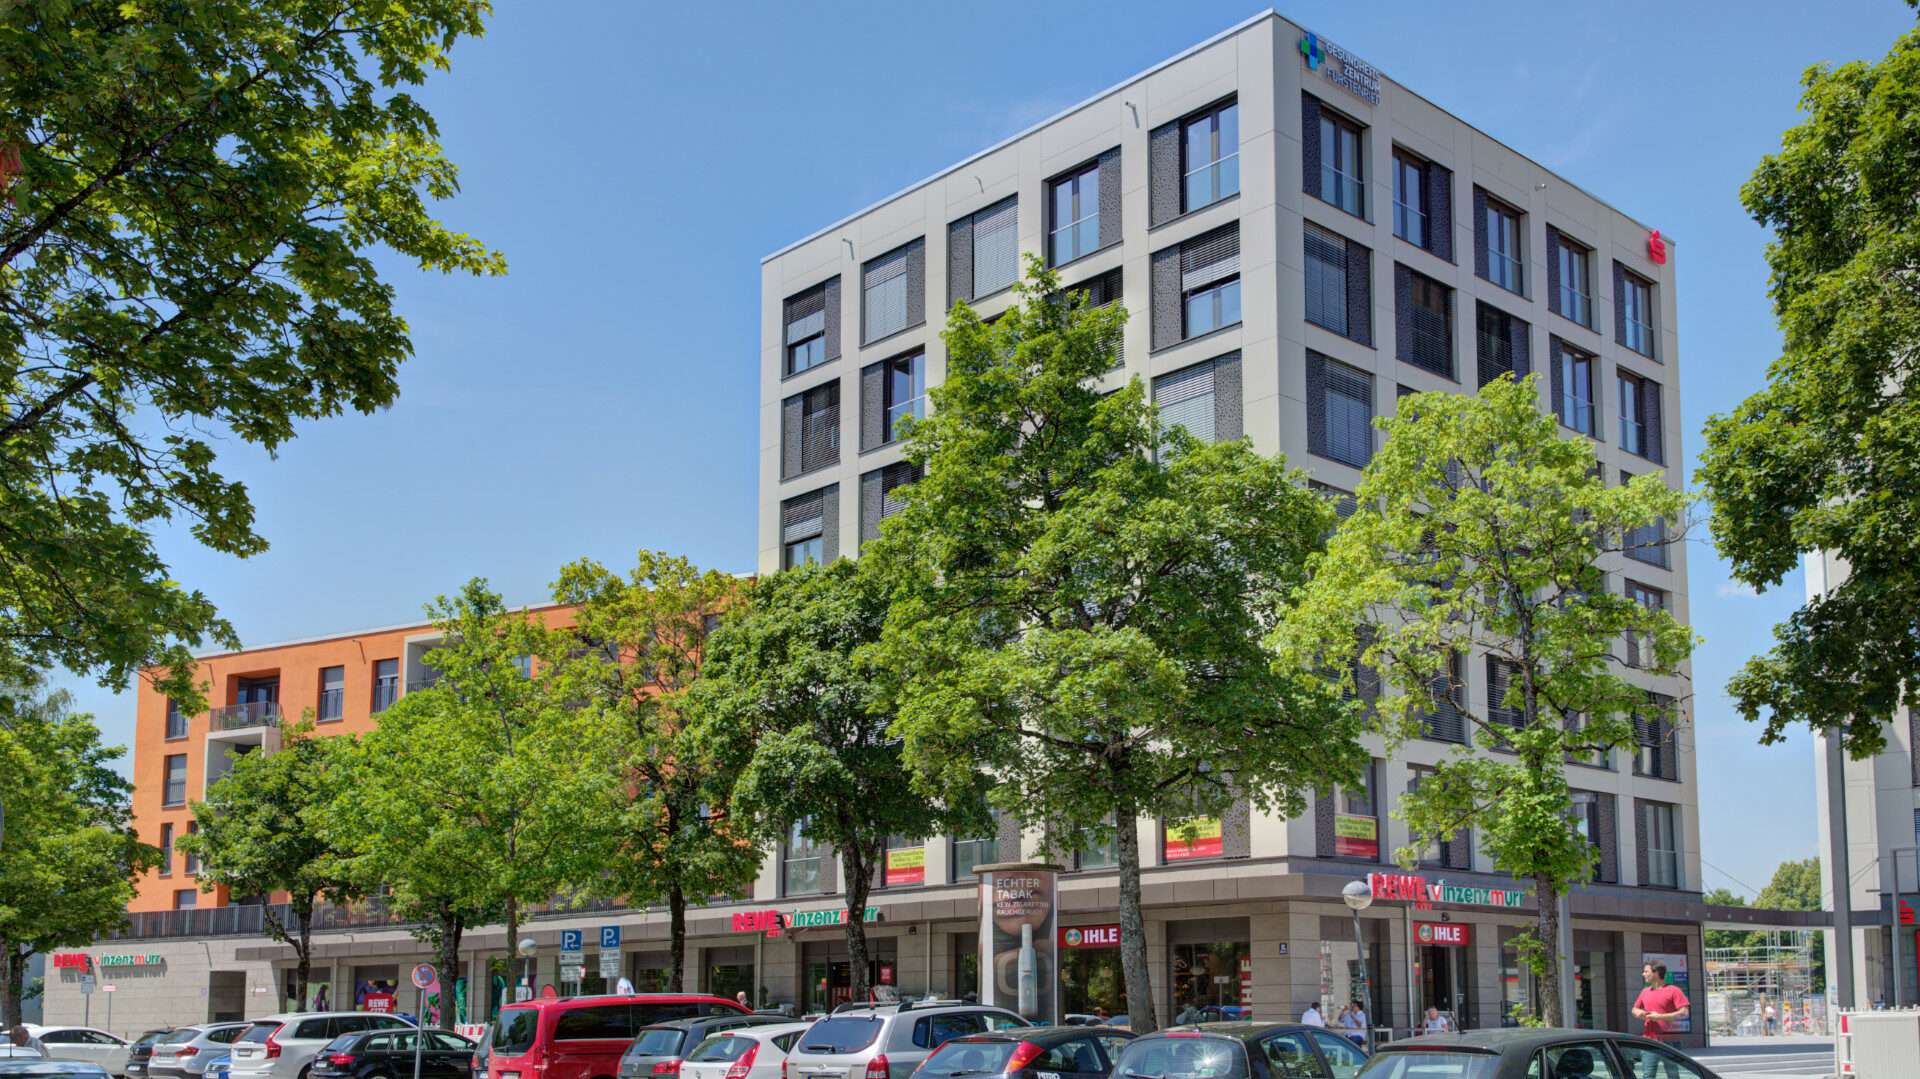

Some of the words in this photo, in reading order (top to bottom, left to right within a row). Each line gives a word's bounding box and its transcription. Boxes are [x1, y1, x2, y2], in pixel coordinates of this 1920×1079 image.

[1343, 65, 1381, 94] ZENTRUM
[997, 878, 1040, 888] ECHTER
[1368, 873, 1427, 900] REWE
[997, 889, 1033, 900] TABAK
[732, 910, 779, 932] REWE
[565, 932, 577, 949] P
[603, 928, 615, 946] P
[1084, 928, 1118, 944] IHLE
[1434, 926, 1461, 942] IHLE
[368, 998, 390, 1008] REWE
